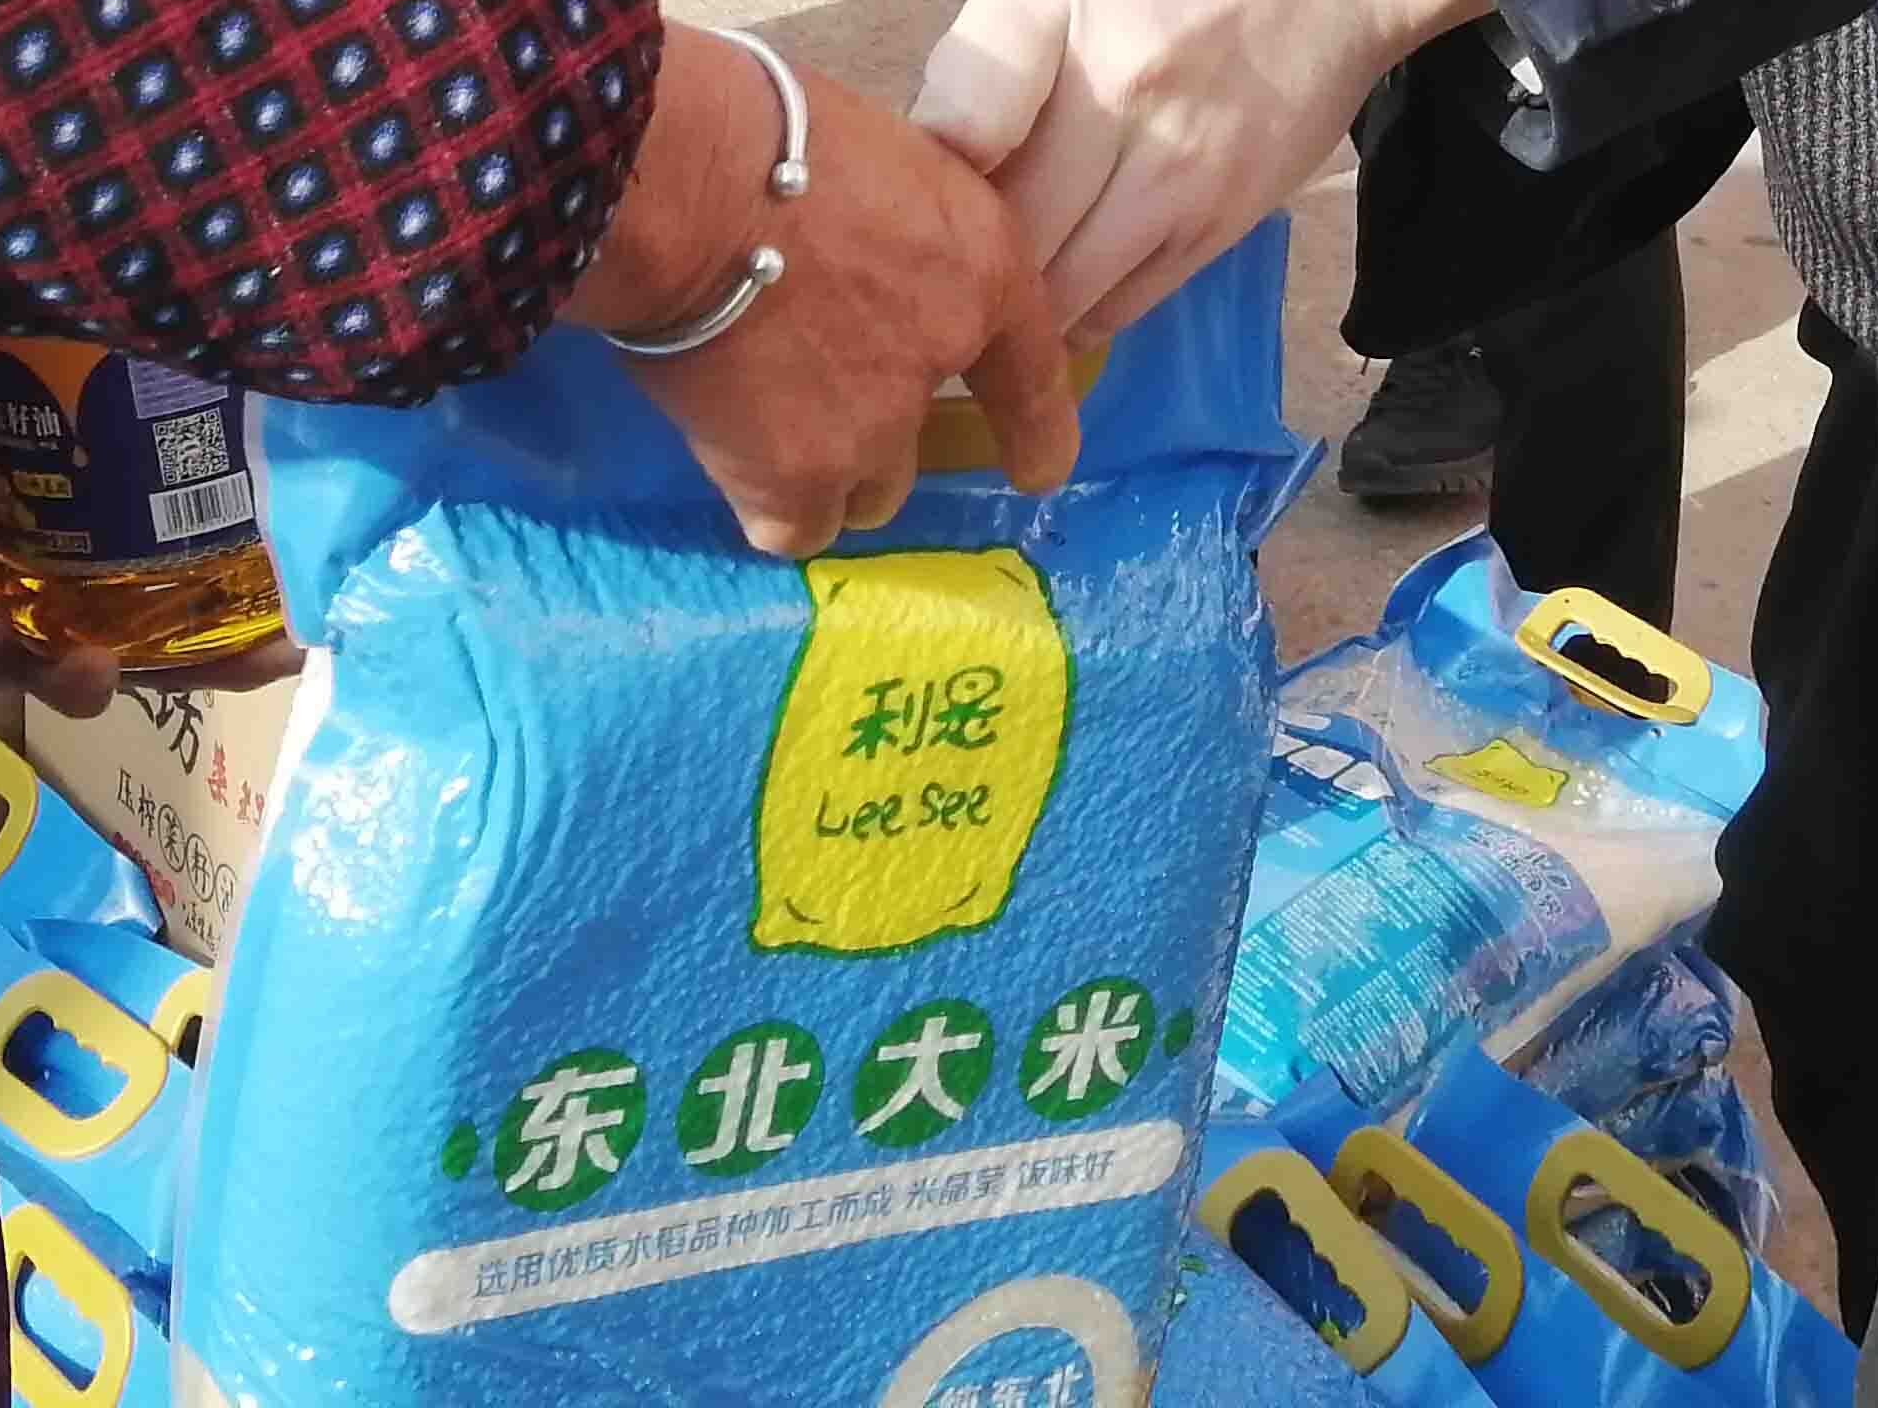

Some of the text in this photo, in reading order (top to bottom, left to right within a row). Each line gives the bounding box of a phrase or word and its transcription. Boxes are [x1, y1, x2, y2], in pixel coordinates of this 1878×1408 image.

[815, 789, 906, 840] Lee
[503, 989, 1142, 1194] 东北大米
